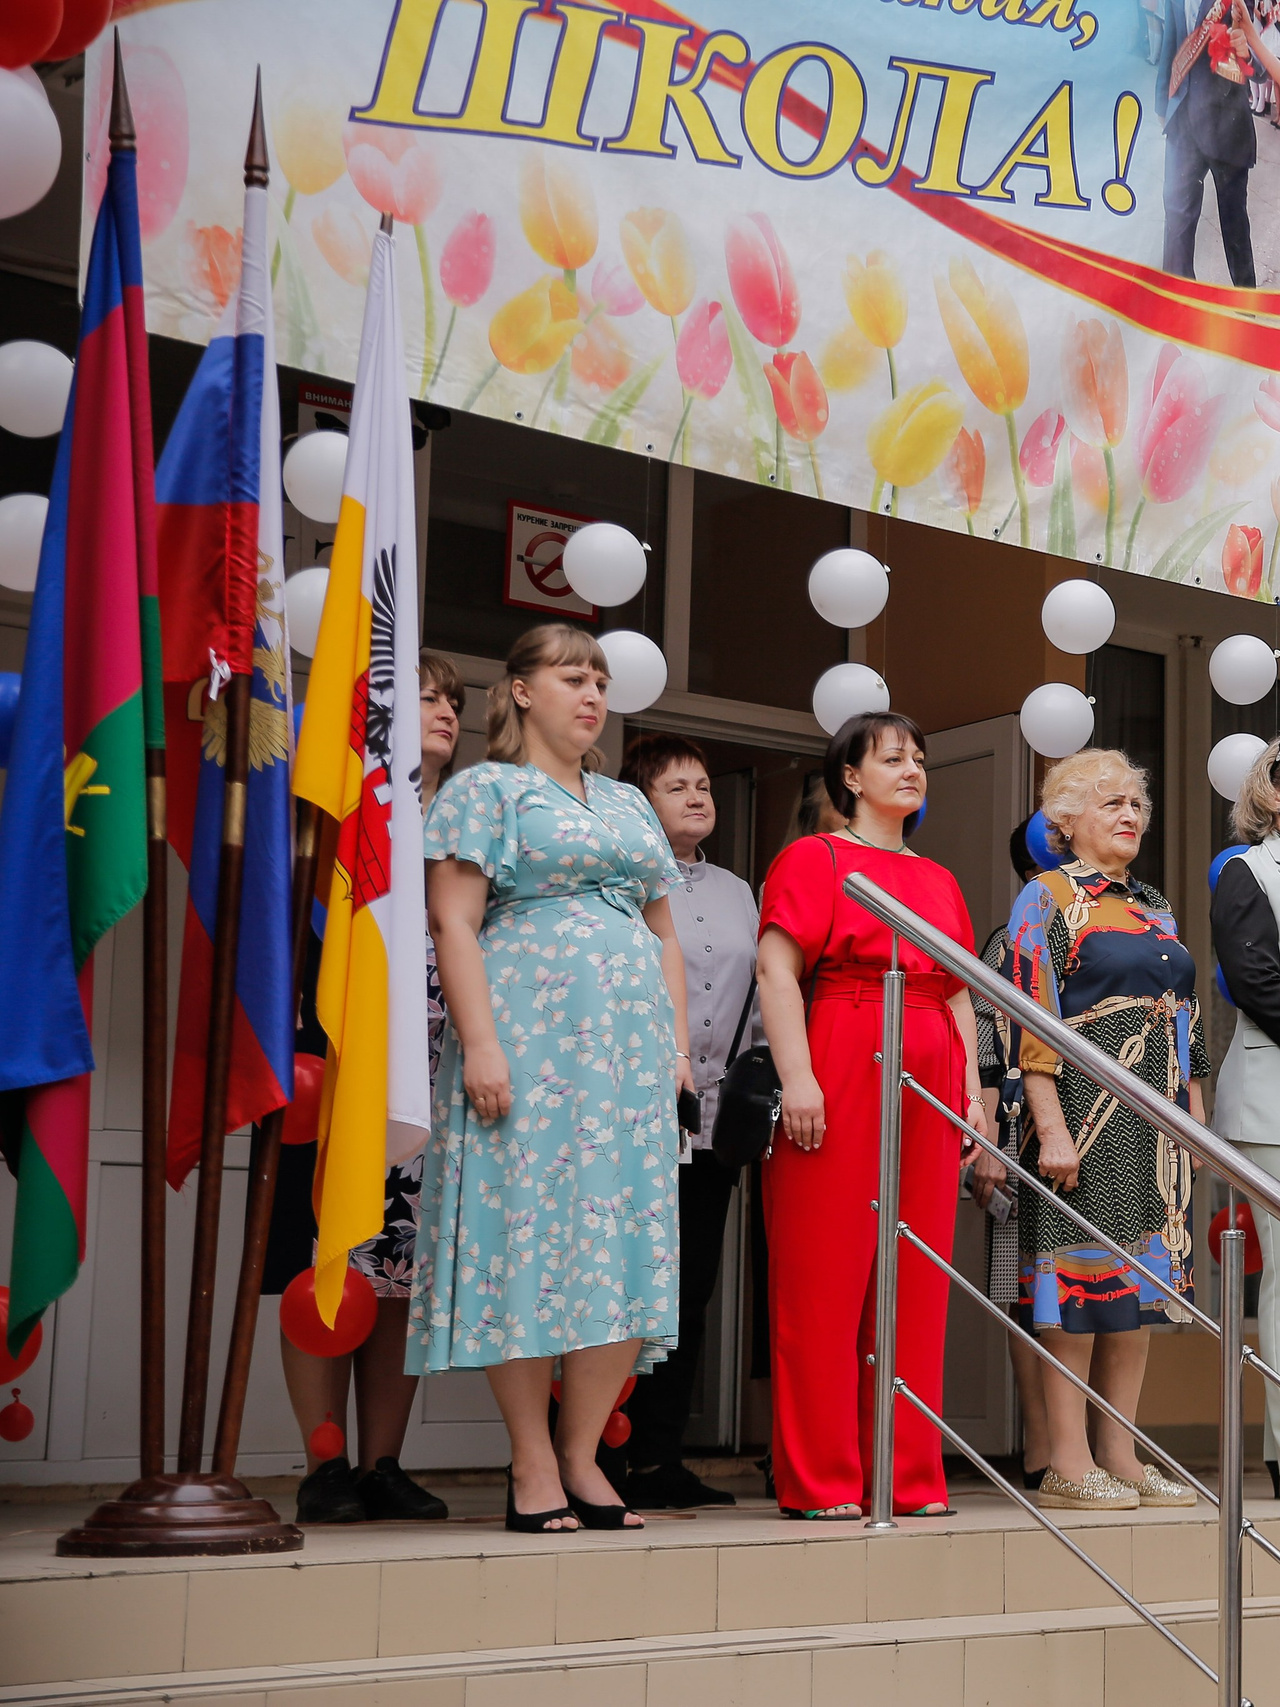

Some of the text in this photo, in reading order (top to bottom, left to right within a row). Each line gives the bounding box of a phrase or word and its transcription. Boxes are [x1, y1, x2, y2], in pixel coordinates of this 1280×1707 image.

[348, 0, 1143, 216] ШКОЛА!
[305, 391, 352, 408] ВНИМАН
[517, 513, 582, 533] КУРЕНИЕ ЗАПРЕЩ
